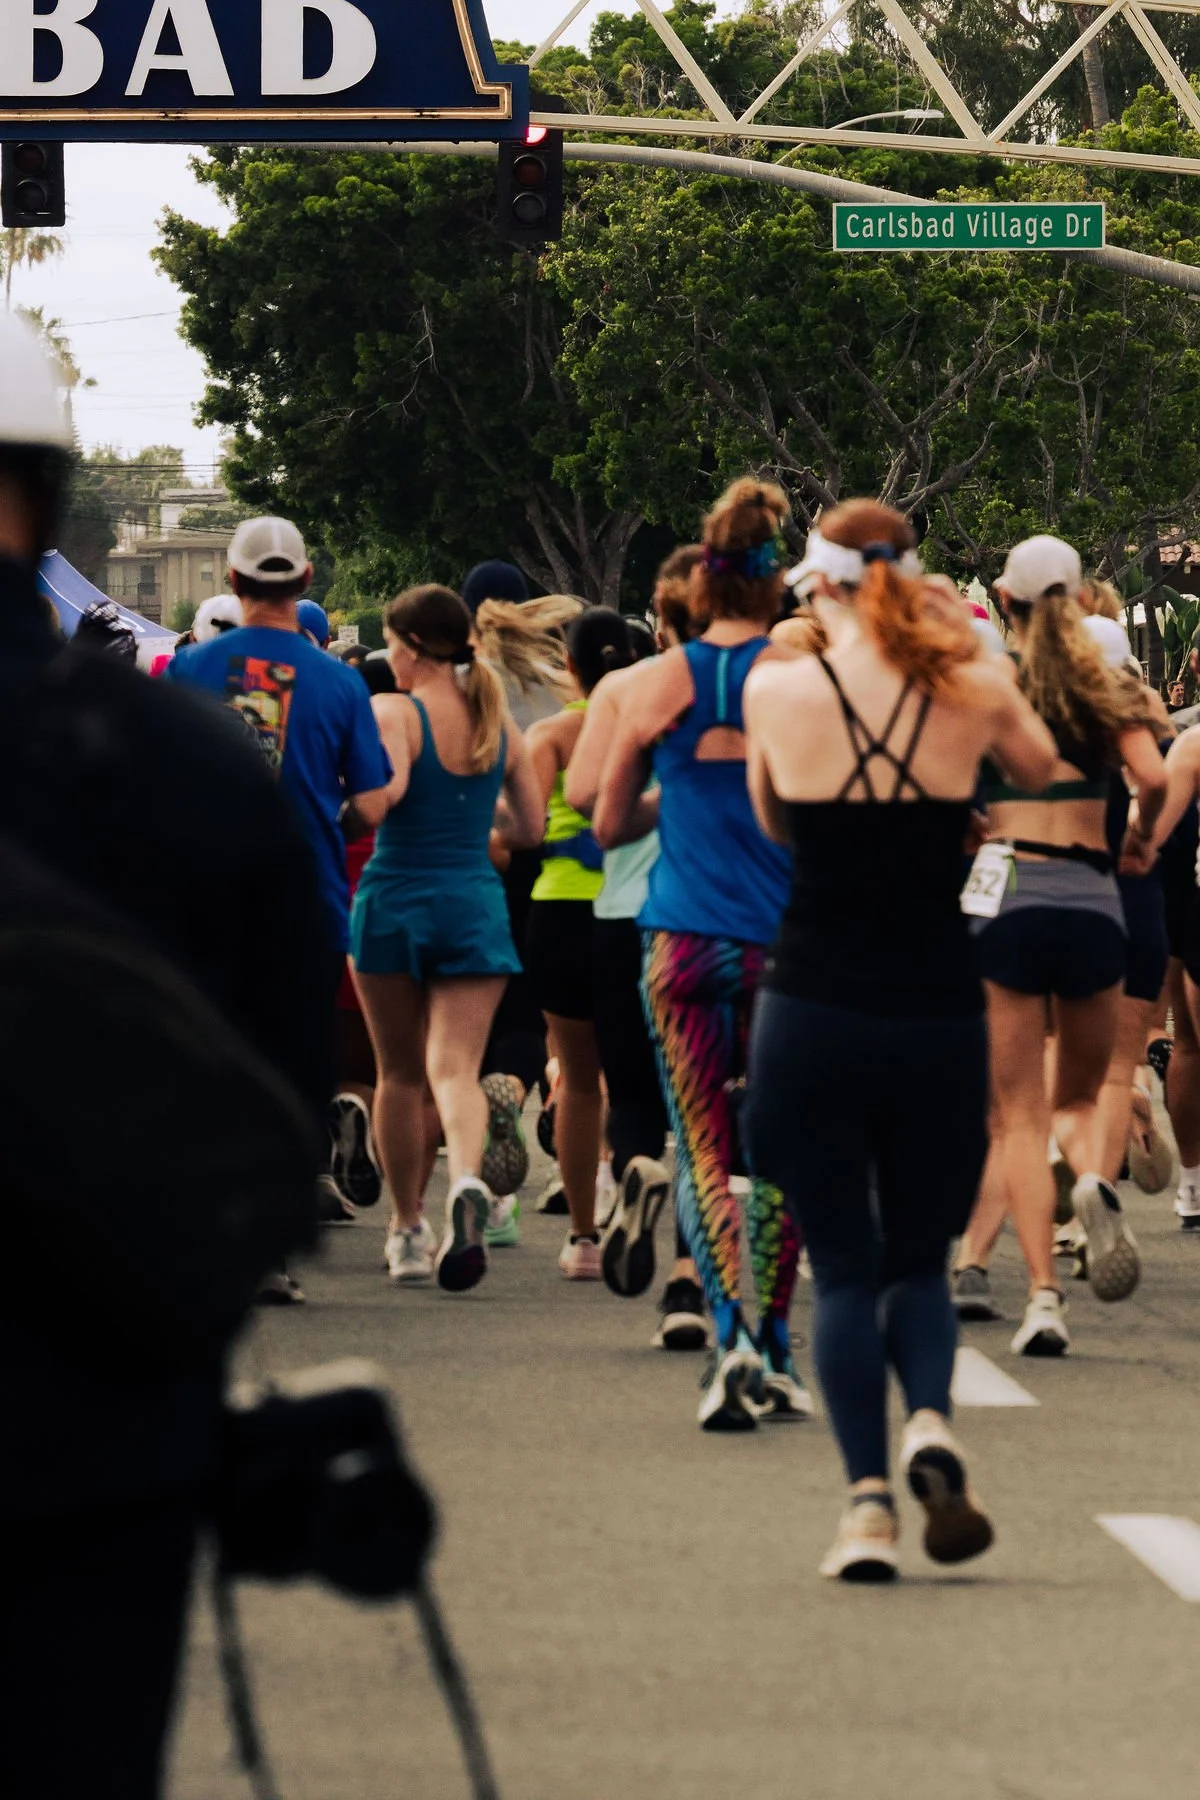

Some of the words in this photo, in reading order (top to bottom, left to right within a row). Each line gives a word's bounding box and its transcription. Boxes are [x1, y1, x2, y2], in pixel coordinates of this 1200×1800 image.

[846, 212, 955, 238] Carlsbad
[966, 211, 1053, 244] Village
[1066, 212, 1092, 238] Dr
